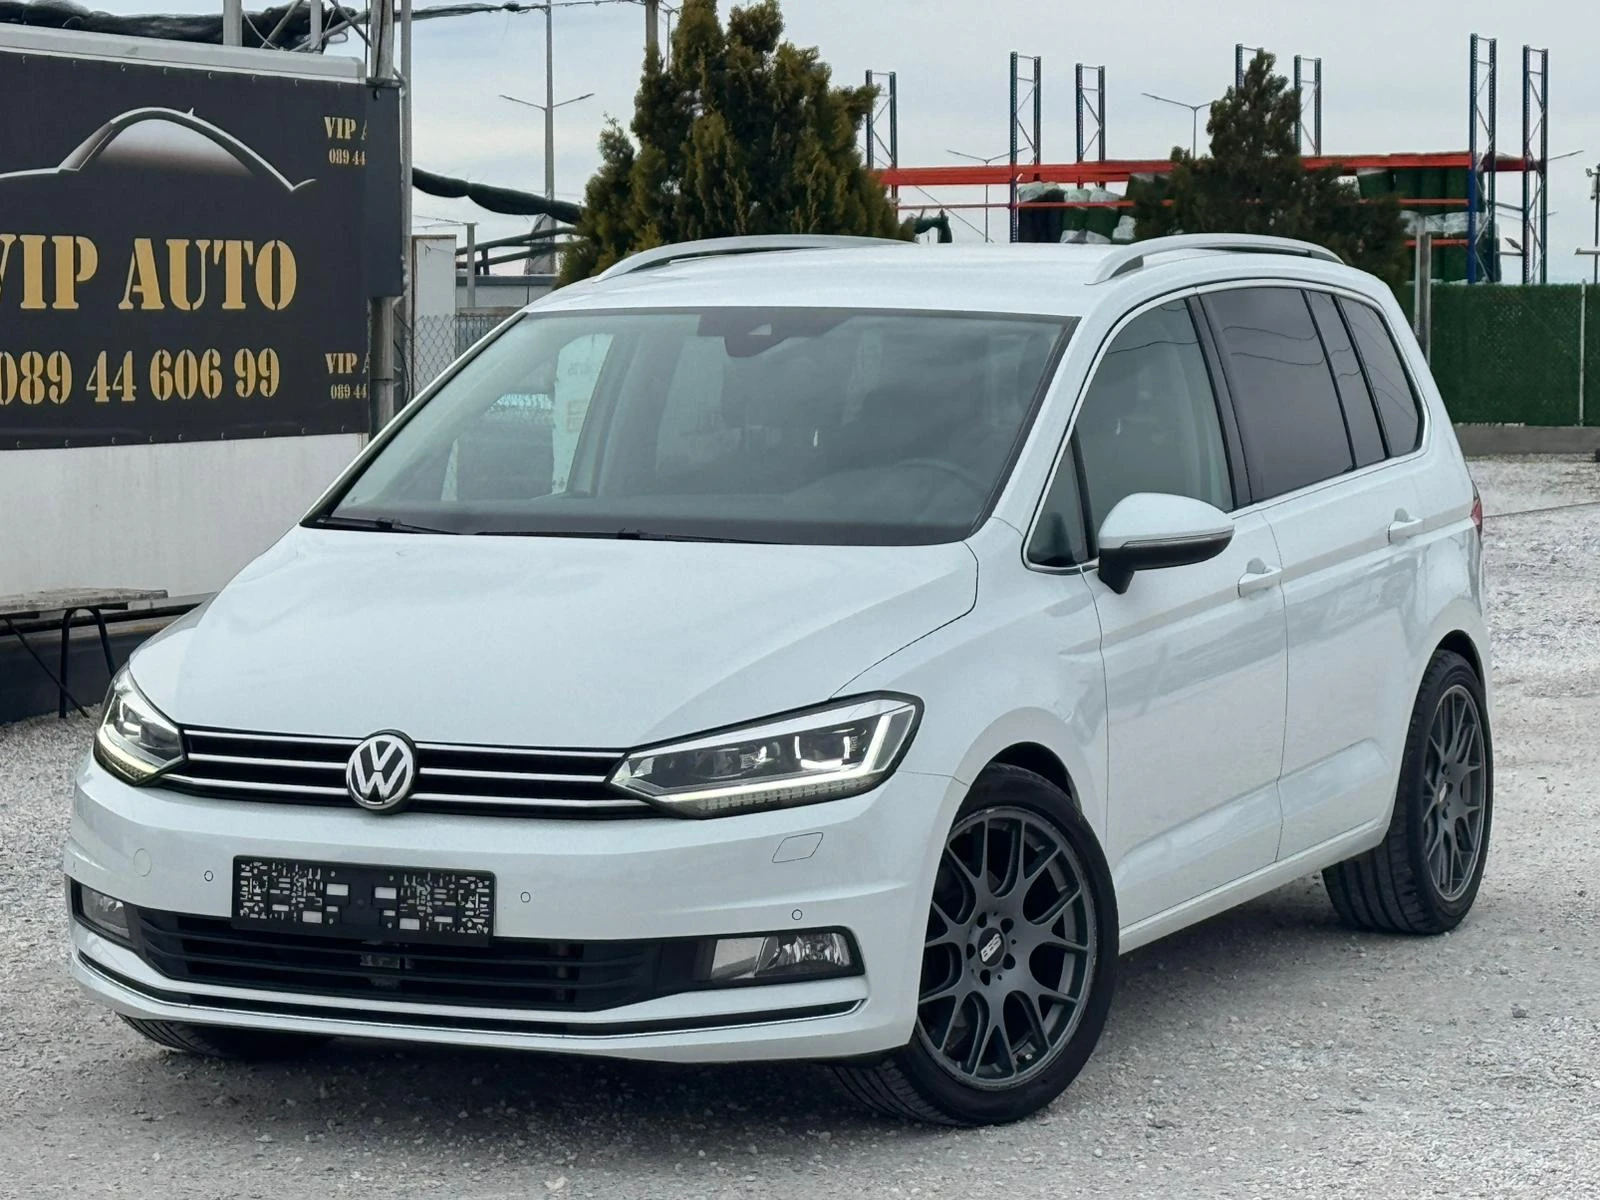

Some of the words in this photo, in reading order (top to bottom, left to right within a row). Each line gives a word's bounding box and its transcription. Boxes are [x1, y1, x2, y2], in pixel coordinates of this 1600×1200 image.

[324, 116, 357, 139] VIP
[328, 148, 350, 164] 089
[118, 237, 297, 311] AUTO
[324, 352, 358, 374] VIP
[0, 350, 73, 405] 089
[86, 350, 137, 403] 44
[150, 348, 223, 401] 606
[234, 347, 280, 398] 99
[330, 383, 351, 399] 089
